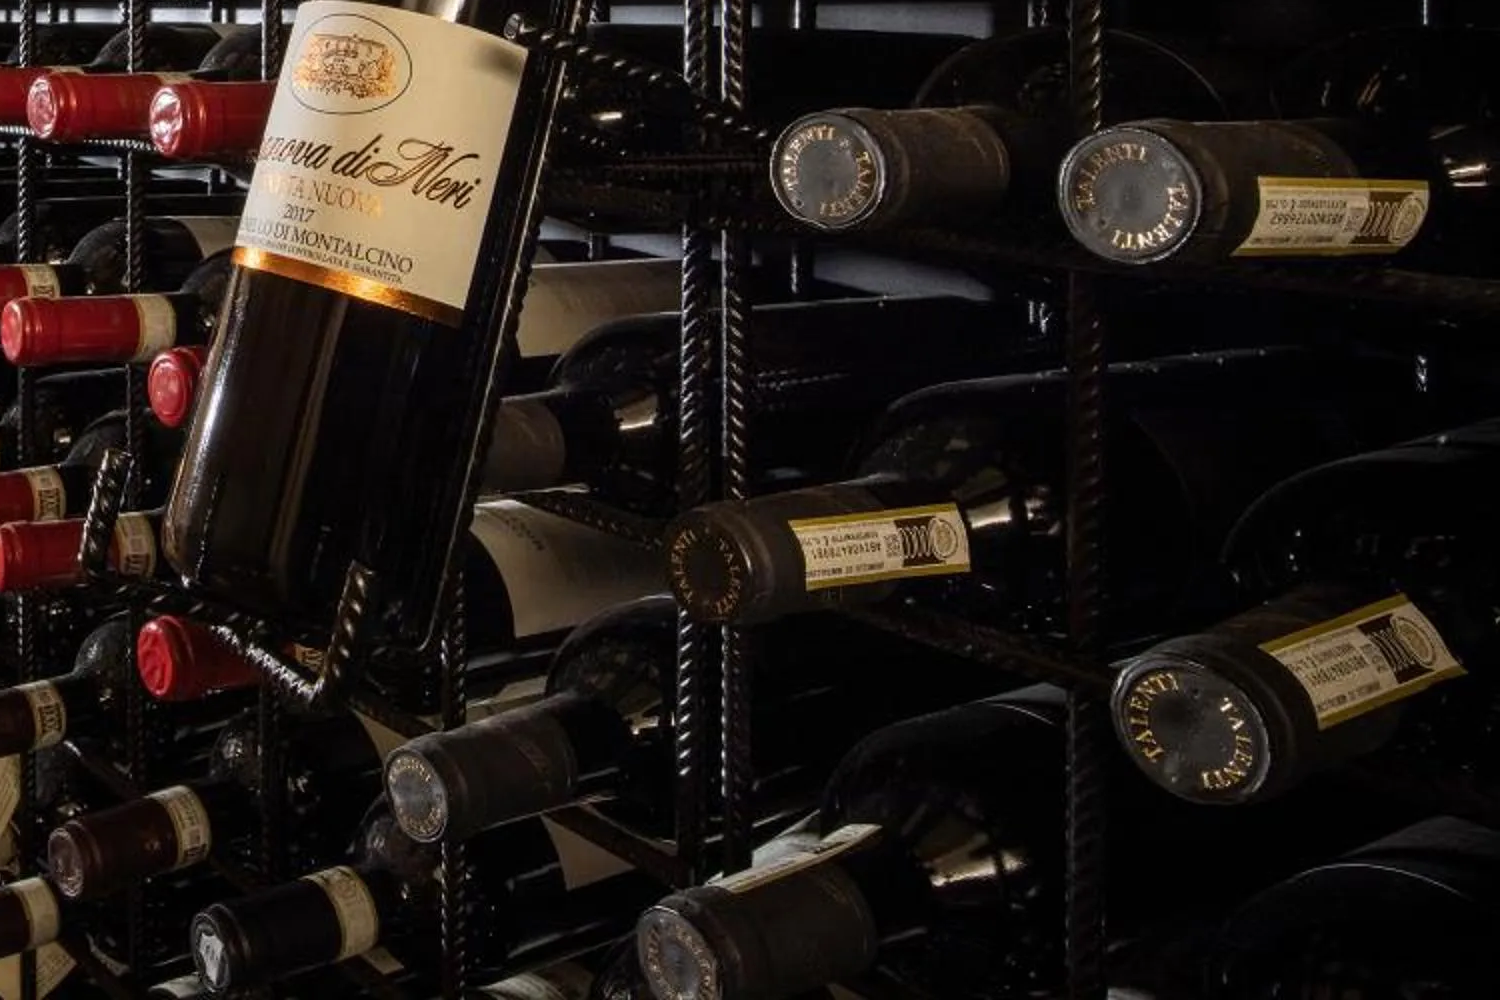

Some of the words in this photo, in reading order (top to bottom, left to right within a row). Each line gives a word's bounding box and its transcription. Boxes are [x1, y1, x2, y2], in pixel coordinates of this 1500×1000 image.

[331, 132, 383, 180] di
[365, 136, 483, 211] Neri
[782, 122, 836, 192] TALENTI
[282, 202, 316, 224] 2017
[1110, 181, 1190, 251] TALENTI
[291, 226, 414, 275] MONTALCINO
[1128, 672, 1180, 764] TALENTI
[1201, 696, 1254, 790] TALENTI
